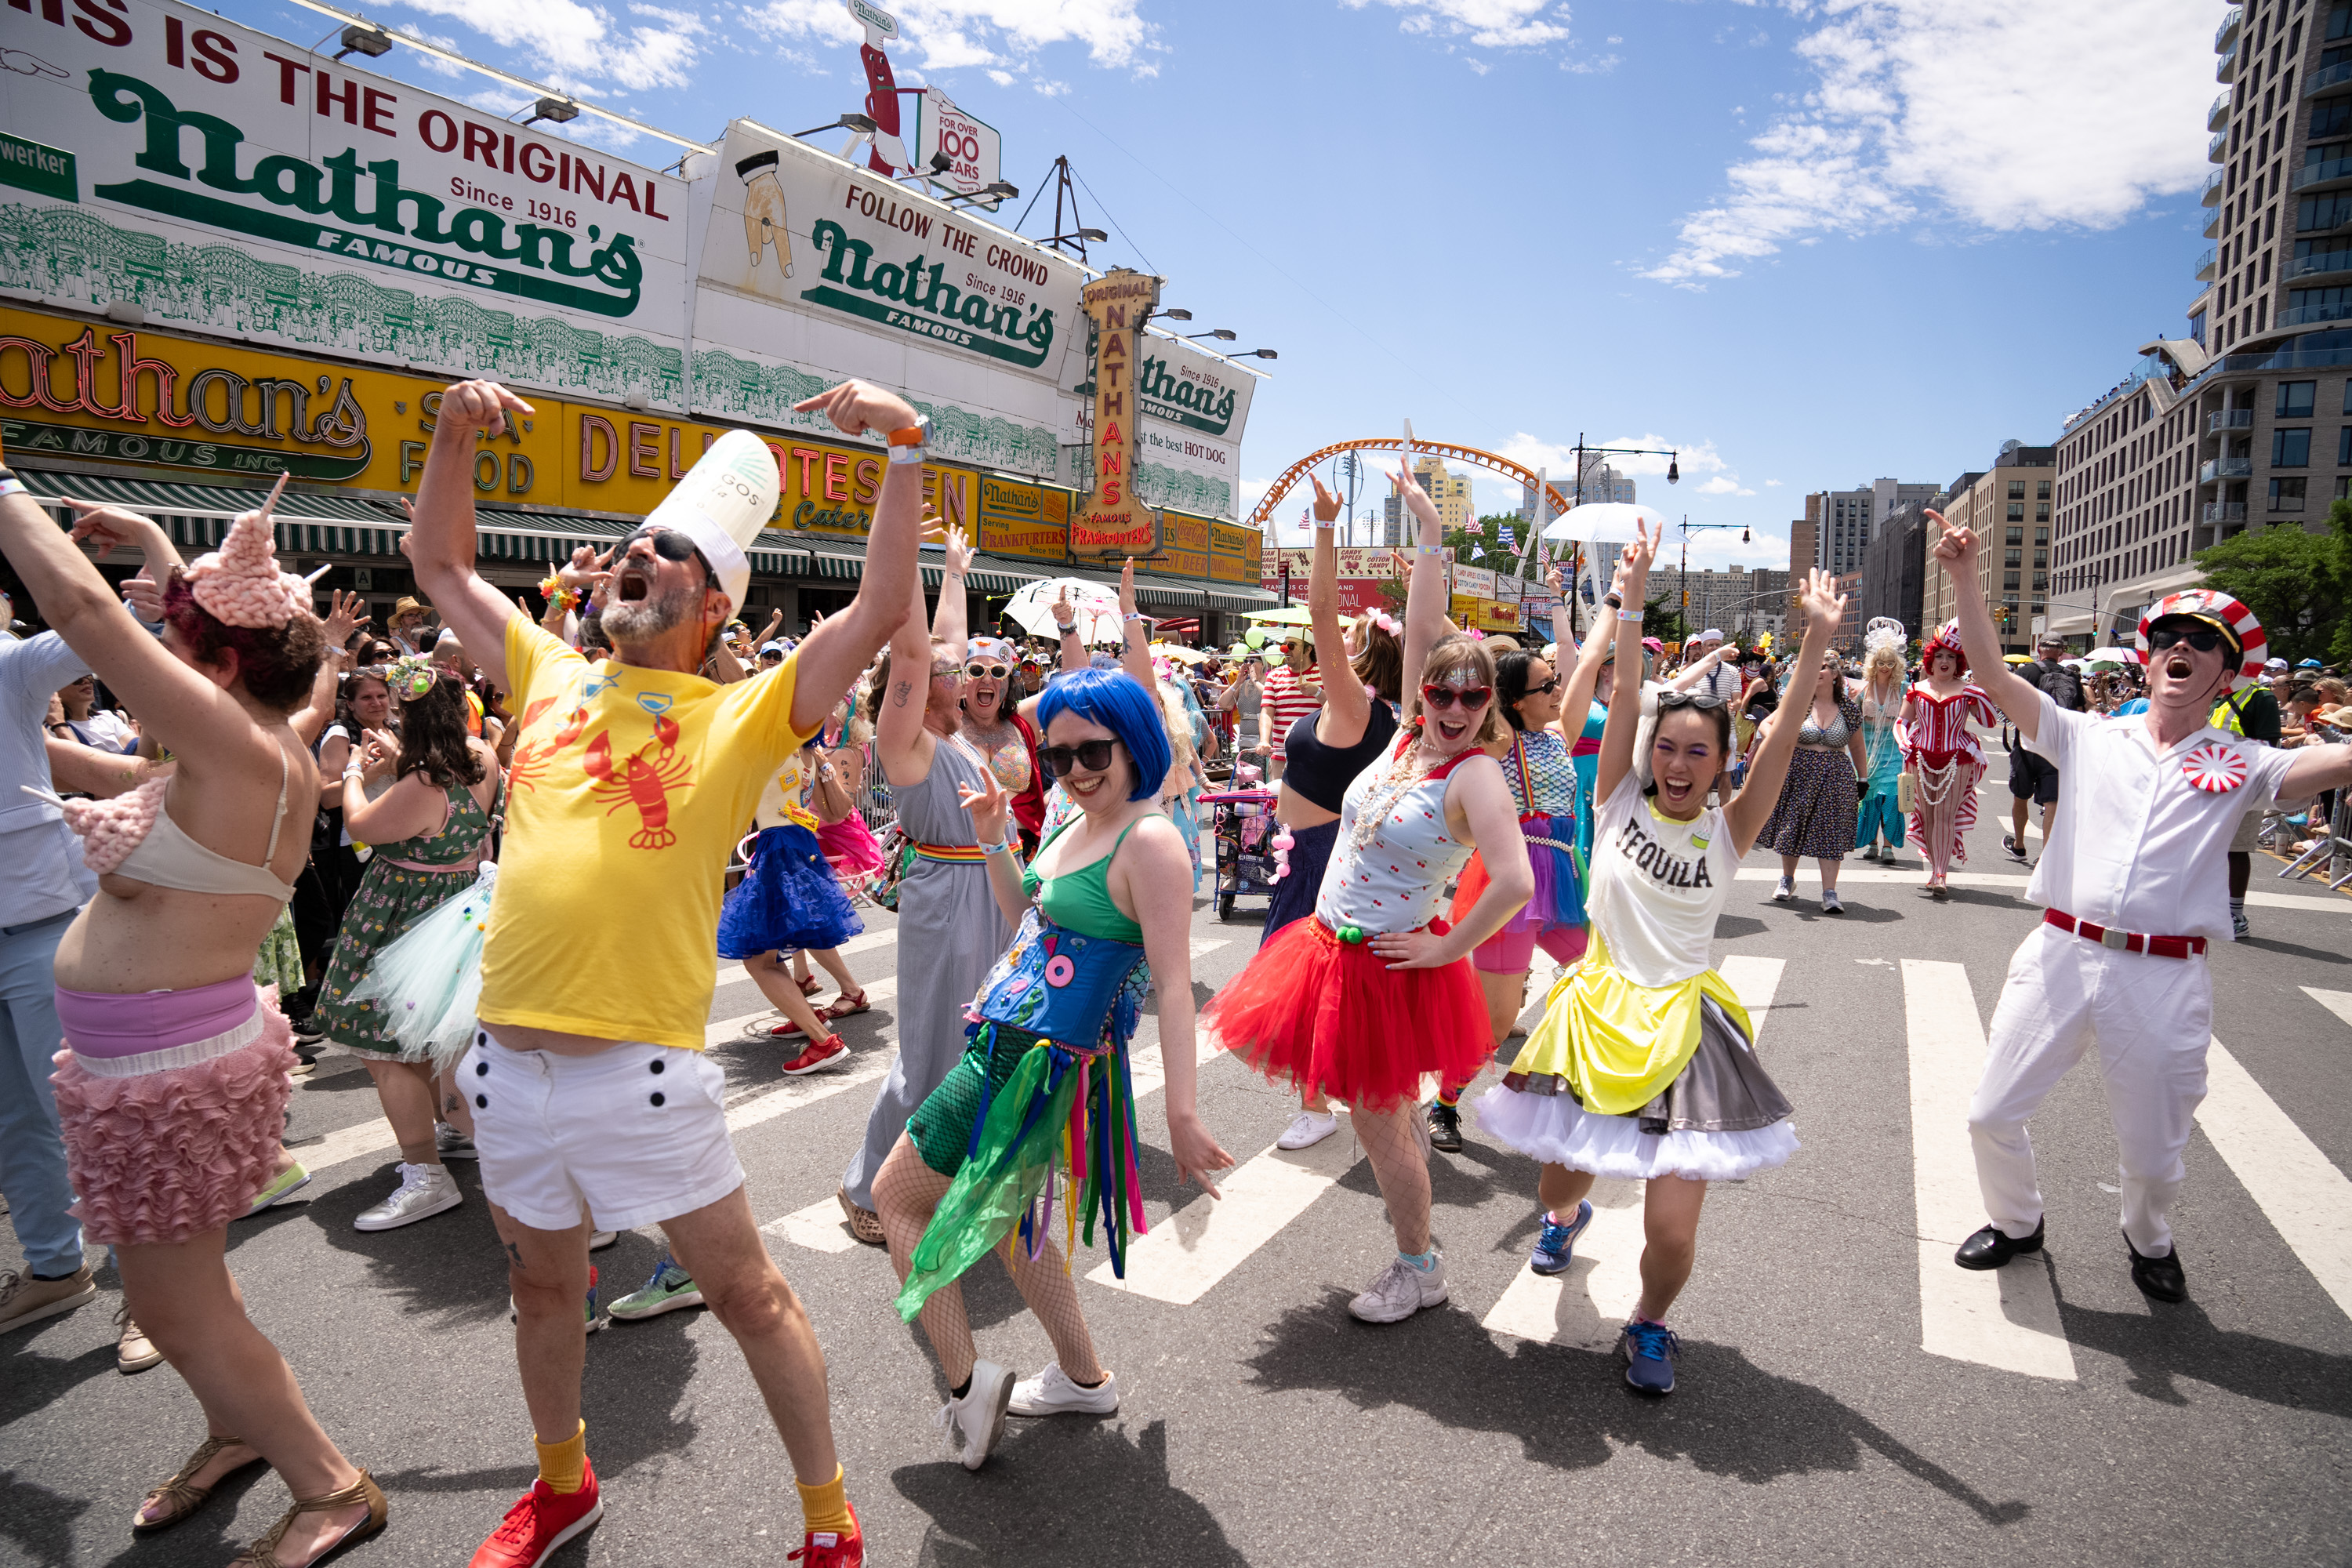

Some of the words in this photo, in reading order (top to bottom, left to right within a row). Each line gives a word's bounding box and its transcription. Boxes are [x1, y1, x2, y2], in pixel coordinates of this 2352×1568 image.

[854, 0, 892, 29] Nathan's
[165, 14, 240, 84] IS
[263, 50, 397, 138] THE
[418, 109, 670, 222] ORIGINAL
[939, 116, 956, 129] FOR
[957, 122, 978, 136] OVER
[938, 128, 979, 163] 100
[86, 67, 643, 290] Nathan's
[947, 158, 979, 180] EARS
[450, 176, 514, 211] Since
[528, 198, 577, 229] 1916
[845, 183, 934, 240] FOLLOW
[942, 223, 978, 259] THE
[986, 243, 1048, 287] CROWD
[317, 230, 498, 286] FAMOUS
[812, 218, 1054, 350] Nathan's
[965, 272, 996, 296] Since
[1000, 285, 1025, 307] 1916
[1087, 281, 1149, 303] ORIGINAL
[886, 310, 973, 346] FAMOUS
[1180, 365, 1200, 383] Since
[1202, 373, 1219, 389] 1916
[1141, 401, 1184, 422] AMOUS
[1149, 433, 1163, 448] the
[1166, 436, 1183, 453] best
[1185, 441, 1205, 459] HOT
[1206, 446, 1226, 466] DOG
[233, 453, 289, 472] INC.
[400, 440, 535, 494] FOD
[984, 482, 1040, 509] Nathan's
[983, 517, 1010, 532] Serving
[1091, 512, 1131, 524] FAMOUS
[981, 528, 1066, 548] FRANKFURTERS
[1071, 521, 1152, 546] FRANKFURTERS
[1210, 527, 1244, 546] Nathan's
[1029, 545, 1047, 555] Since
[1047, 547, 1065, 557] 1916.
[1150, 551, 1181, 568] ROOT
[1182, 554, 1207, 572] BEER
[1245, 569, 1260, 580] HERE!
[1246, 559, 1261, 569] ORDER
[358, 571, 368, 584] A
[1616, 817, 1714, 887] TEQUILA
